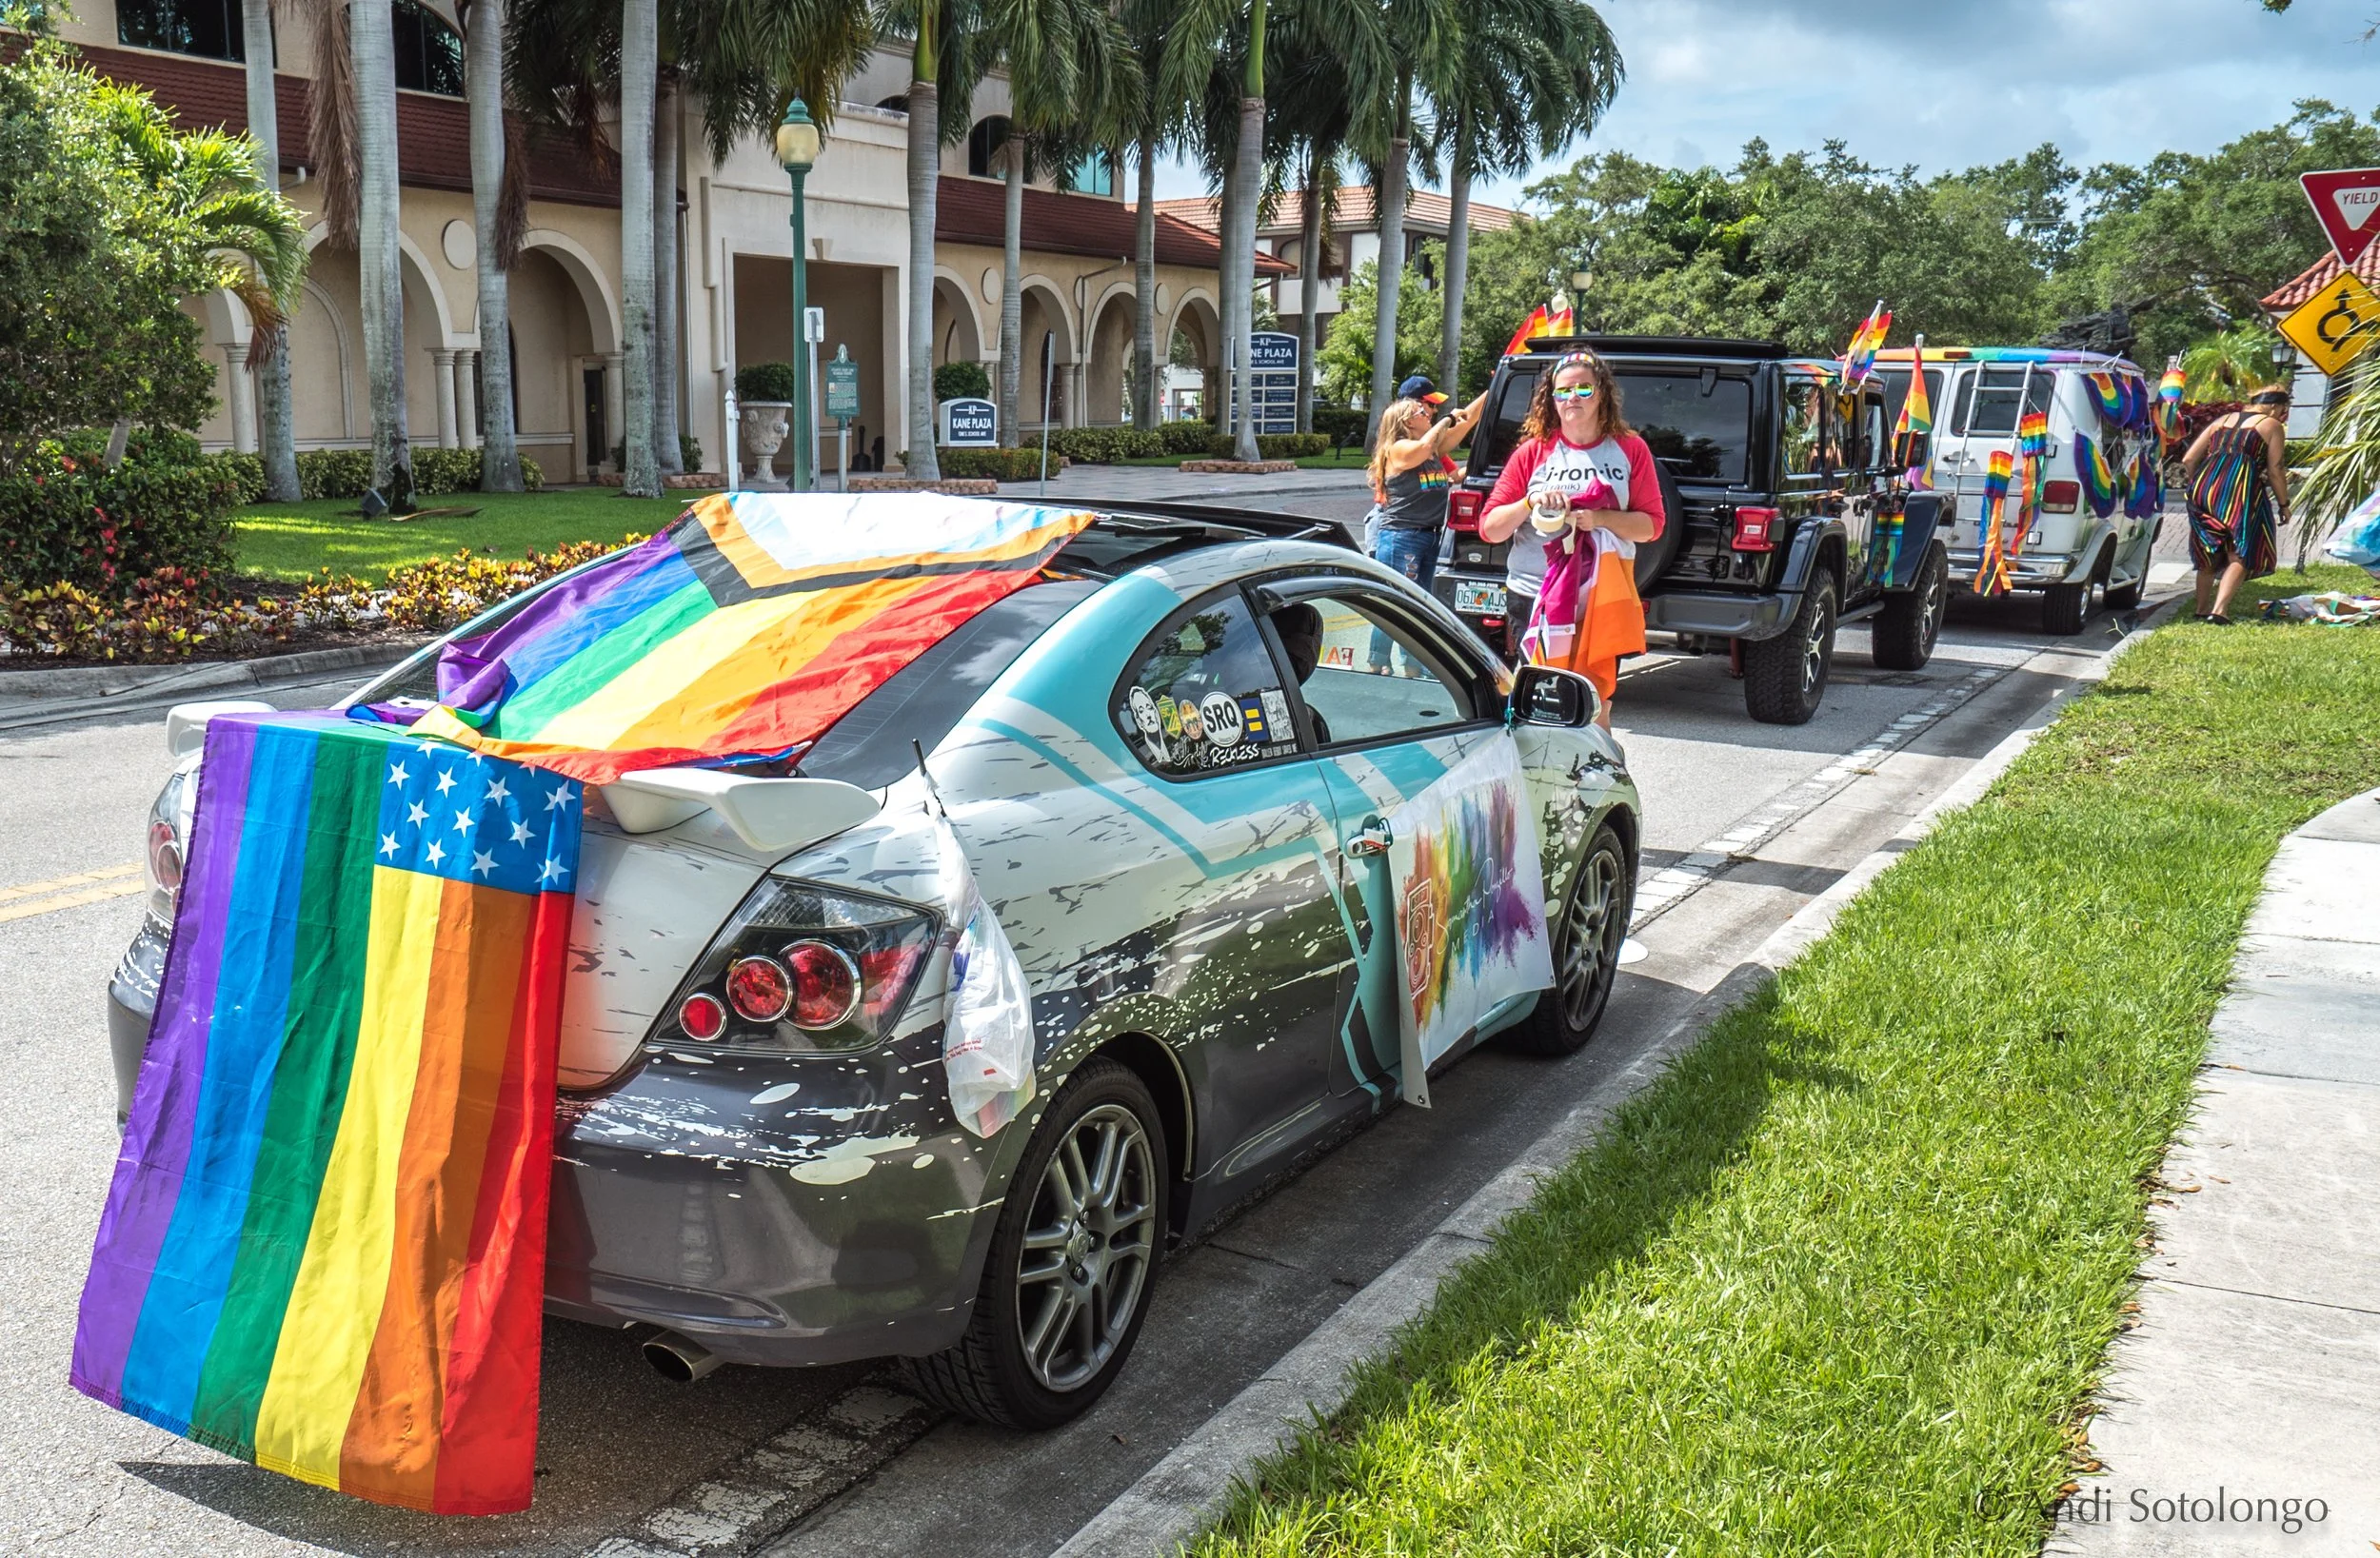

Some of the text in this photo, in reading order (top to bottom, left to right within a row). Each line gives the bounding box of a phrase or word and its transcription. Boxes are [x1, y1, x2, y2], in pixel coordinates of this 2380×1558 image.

[2343, 192, 2378, 205] YIELD
[1259, 337, 1271, 346] KP
[1264, 348, 1293, 358] PLAZA
[952, 418, 992, 428] KANE PLAZA
[1203, 700, 1239, 733] SRQ
[1452, 909, 1494, 952] MEDIA
